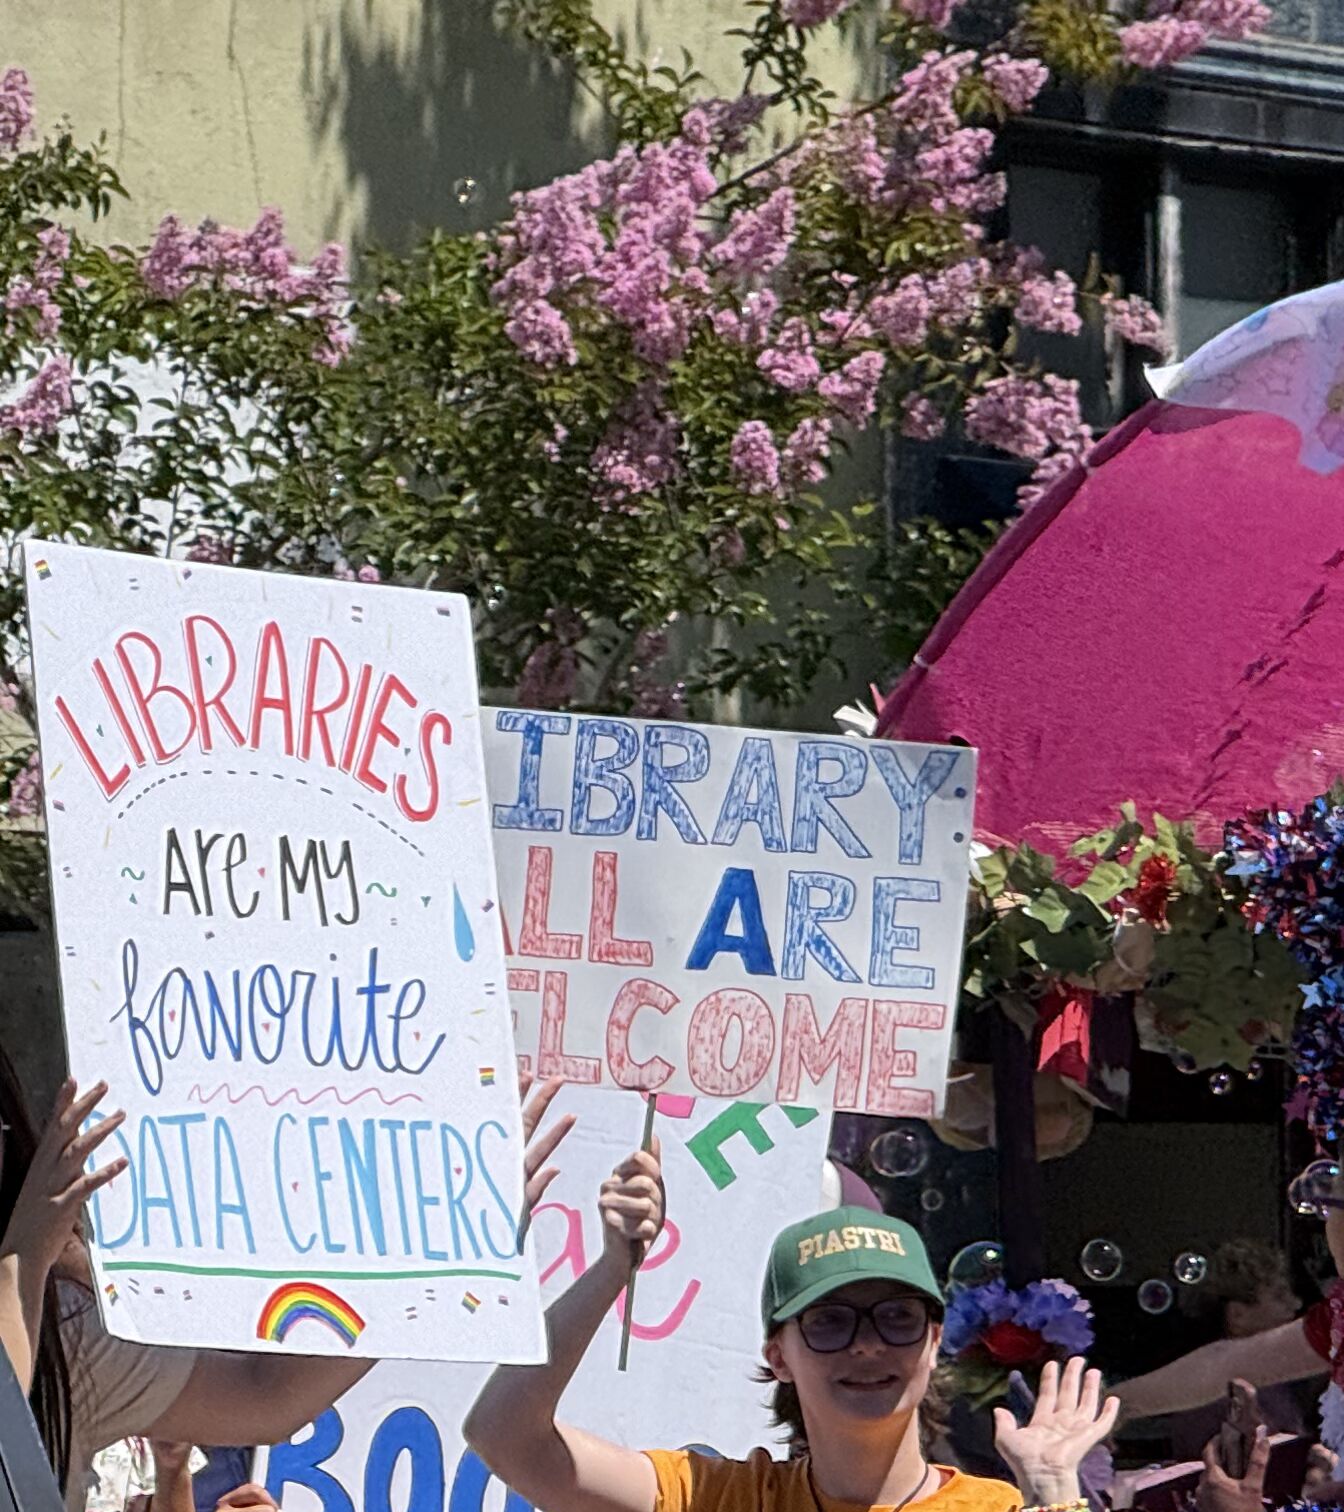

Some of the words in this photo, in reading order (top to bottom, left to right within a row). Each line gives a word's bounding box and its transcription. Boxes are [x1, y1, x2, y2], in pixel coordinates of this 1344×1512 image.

[56, 615, 452, 822] LIBRARIES
[492, 711, 959, 864] IBRARY
[500, 845, 654, 968] LL
[685, 867, 941, 989] ARE
[110, 939, 447, 1096] favorite
[83, 1112, 256, 1254] DATA
[272, 1113, 522, 1262] CENTERS
[798, 1227, 906, 1266] PIASTRI
